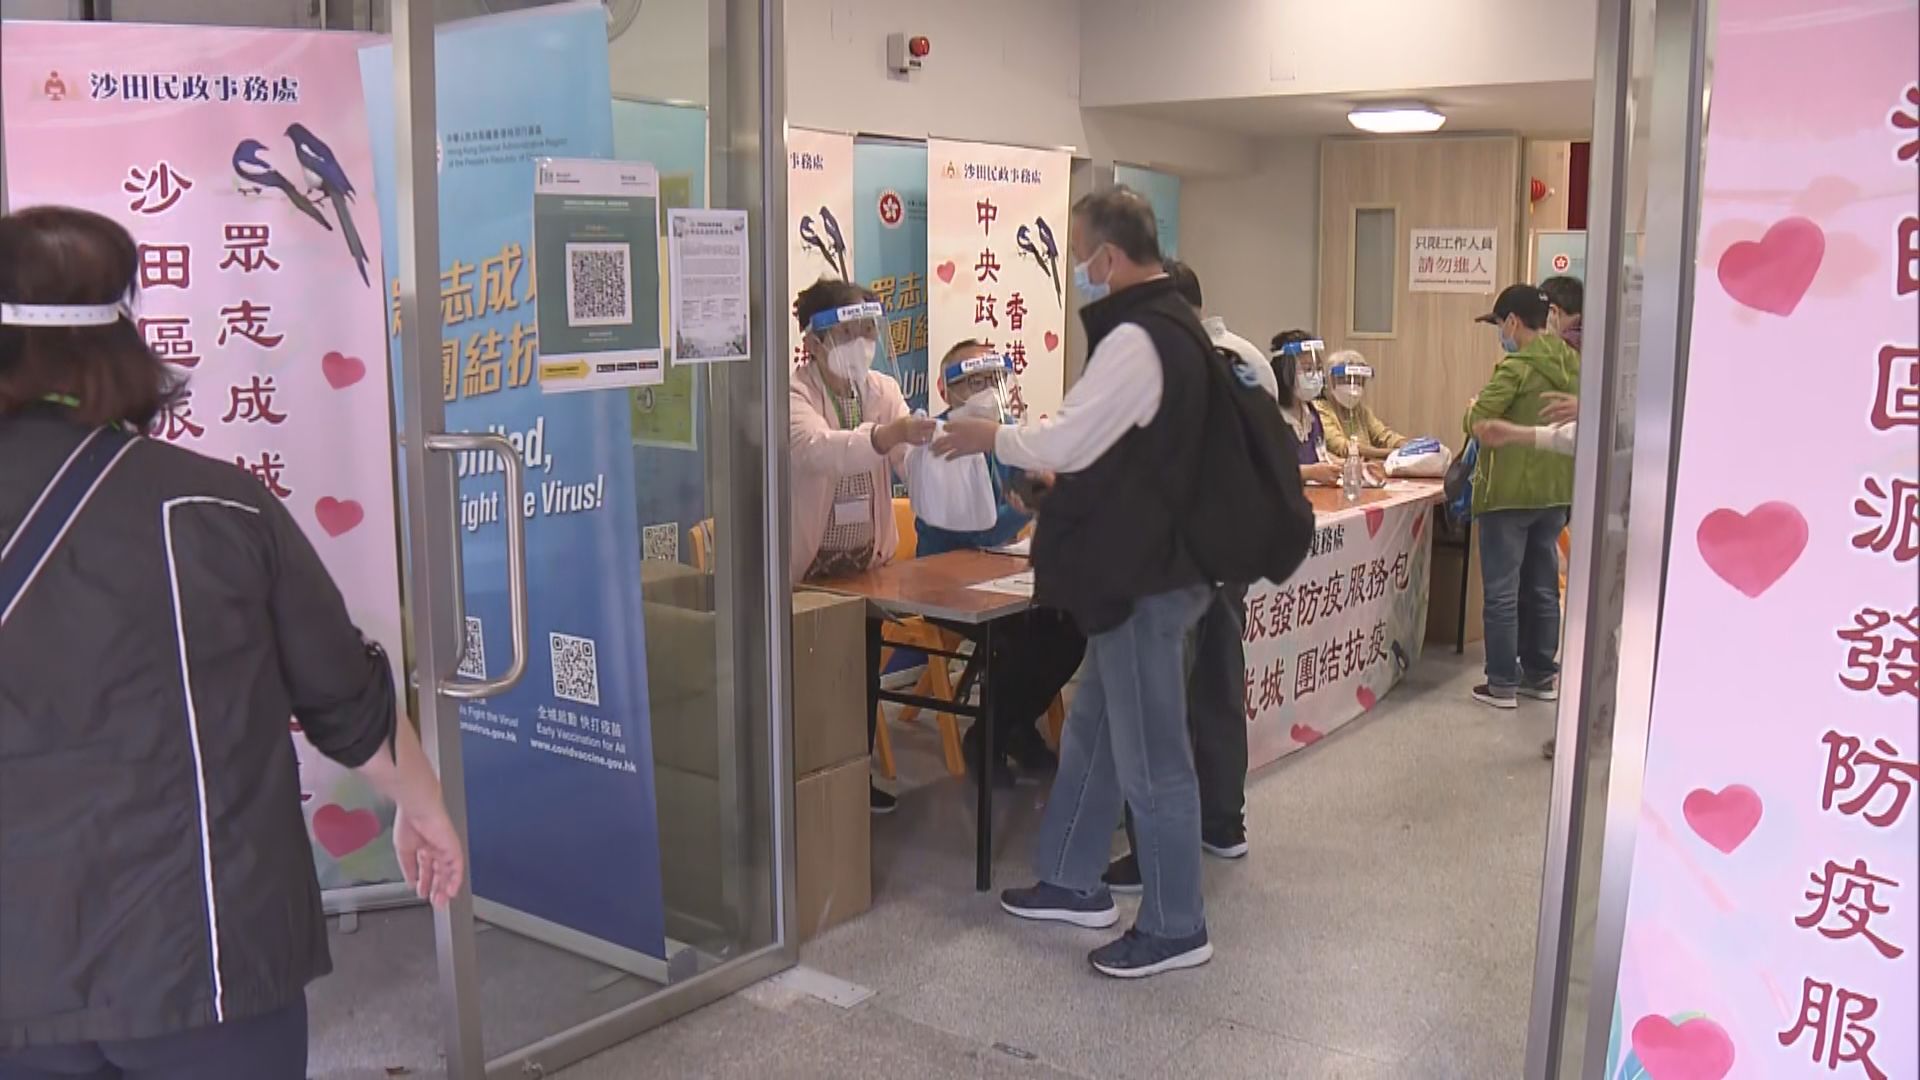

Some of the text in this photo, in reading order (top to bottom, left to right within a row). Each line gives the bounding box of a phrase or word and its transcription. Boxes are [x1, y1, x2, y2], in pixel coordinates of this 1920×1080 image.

[90, 73, 299, 101] 沙田民政事務處
[963, 162, 1042, 184] 沙田民政事務處
[1415, 235, 1493, 251] 只限工作人員
[391, 241, 536, 339] 志成
[871, 273, 928, 312] 眾志
[461, 491, 499, 532] ight
[541, 474, 605, 514] Virus!
[1293, 619, 1388, 701] 團結抗疫
[536, 721, 556, 739] Early
[556, 728, 602, 750] Vaccination
